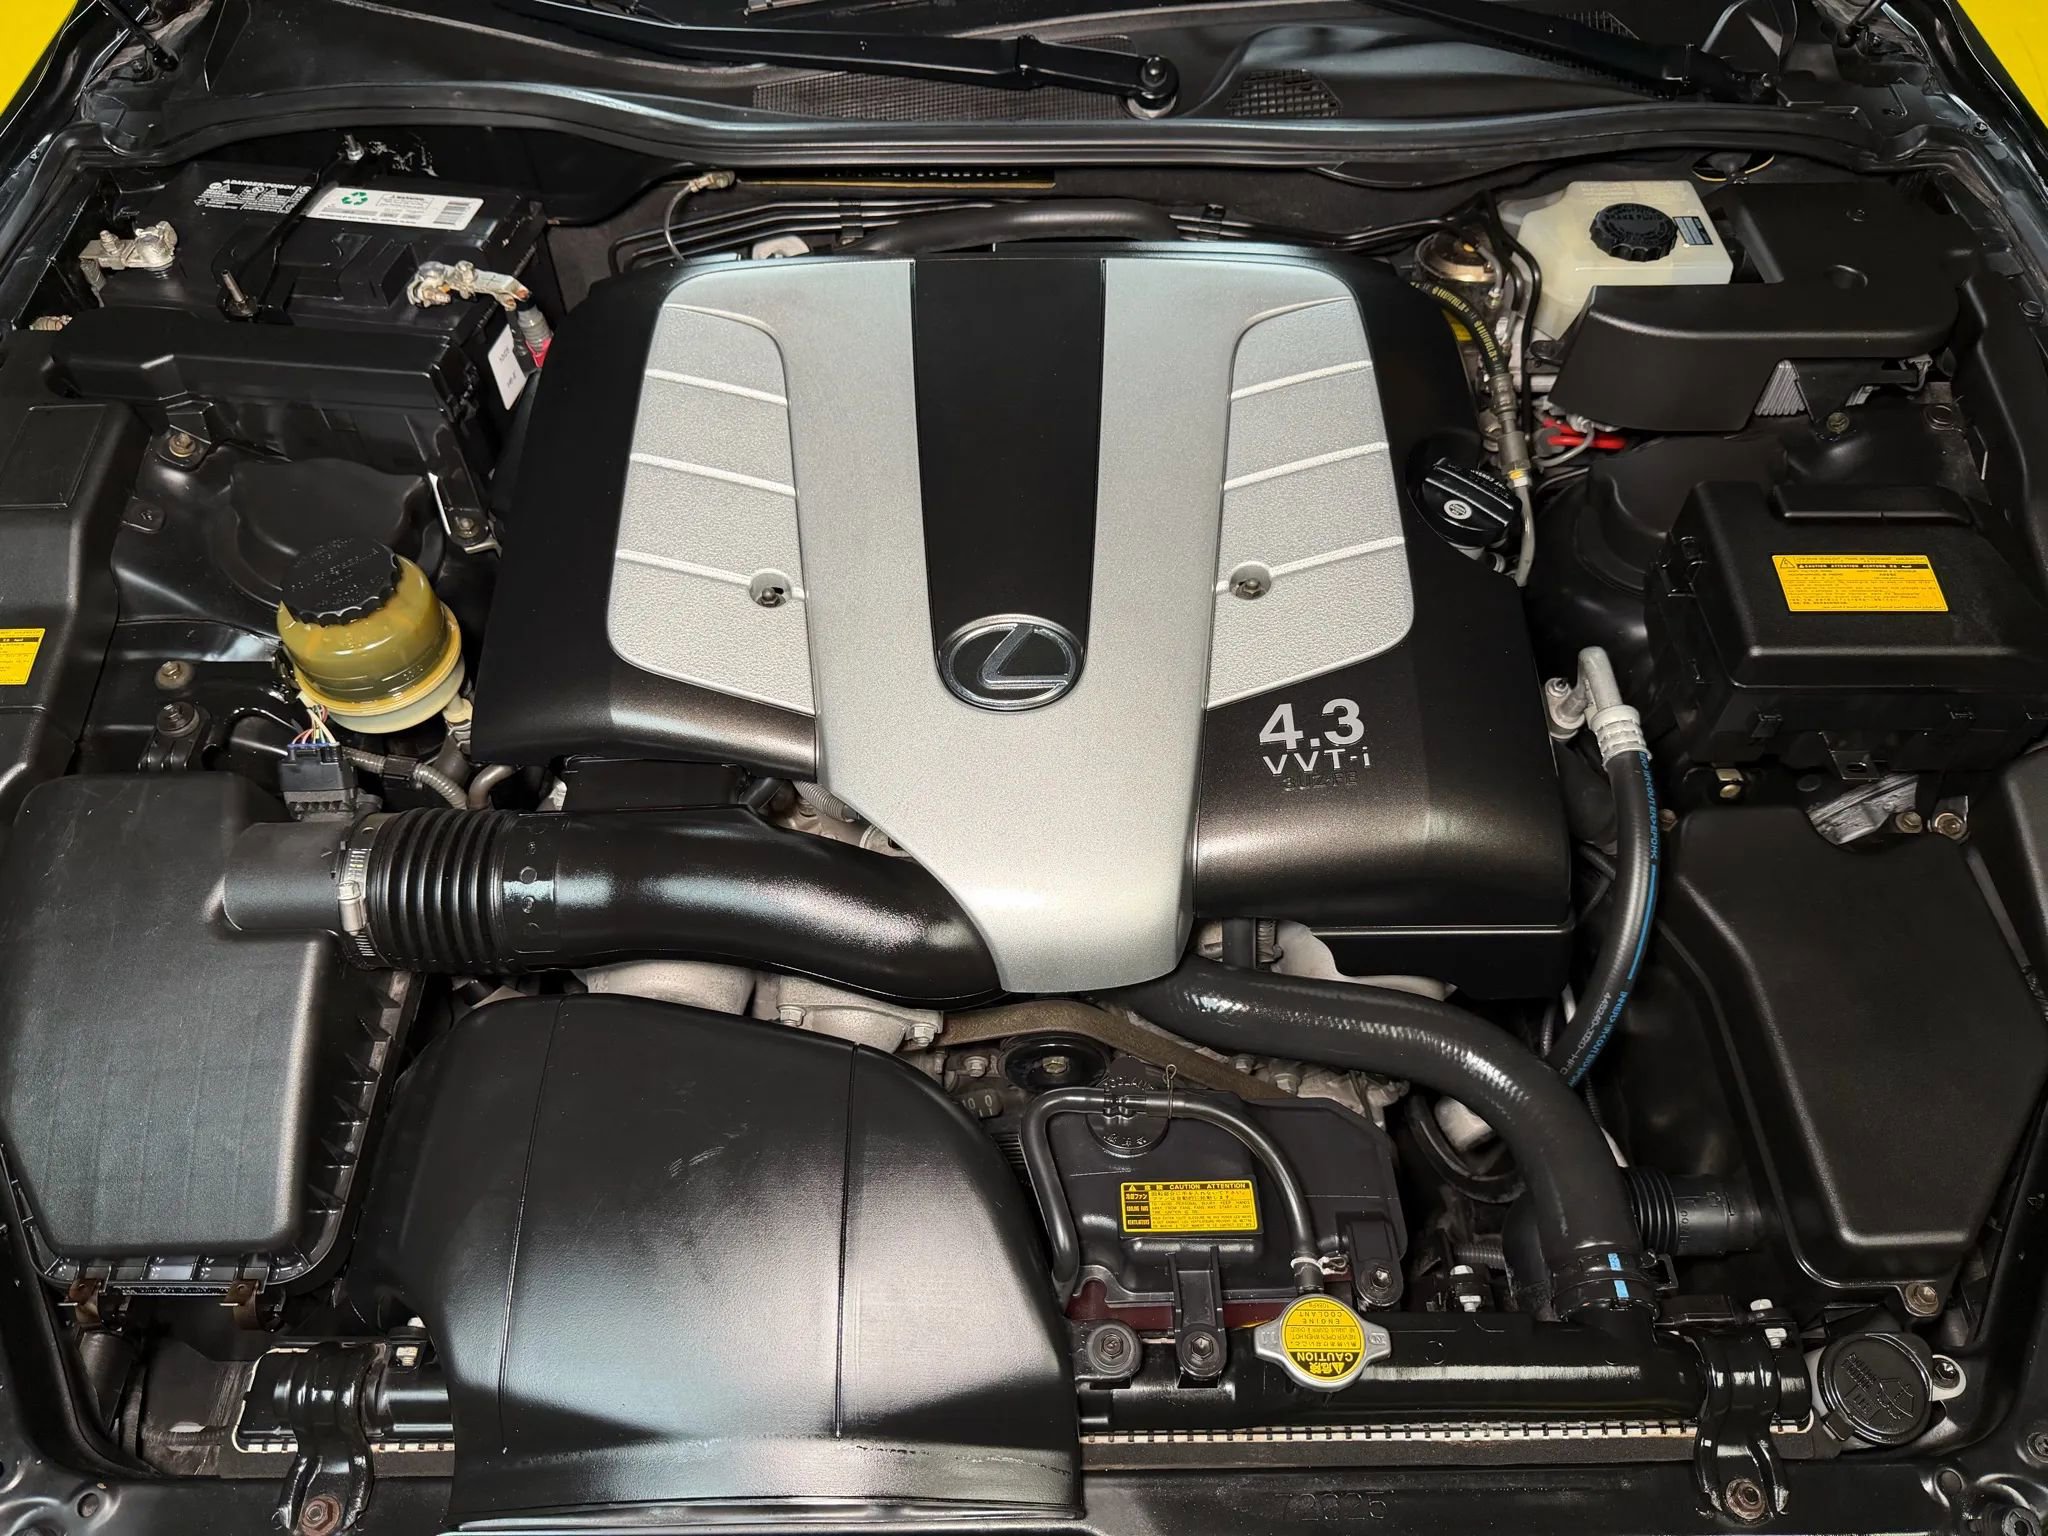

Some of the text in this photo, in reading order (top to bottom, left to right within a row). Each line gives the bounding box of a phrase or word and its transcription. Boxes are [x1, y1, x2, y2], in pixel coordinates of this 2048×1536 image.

[1259, 698, 1365, 750] 4.3
[1263, 746, 1370, 775] VVT-i
[1297, 1352, 1353, 1361] CAUTION
